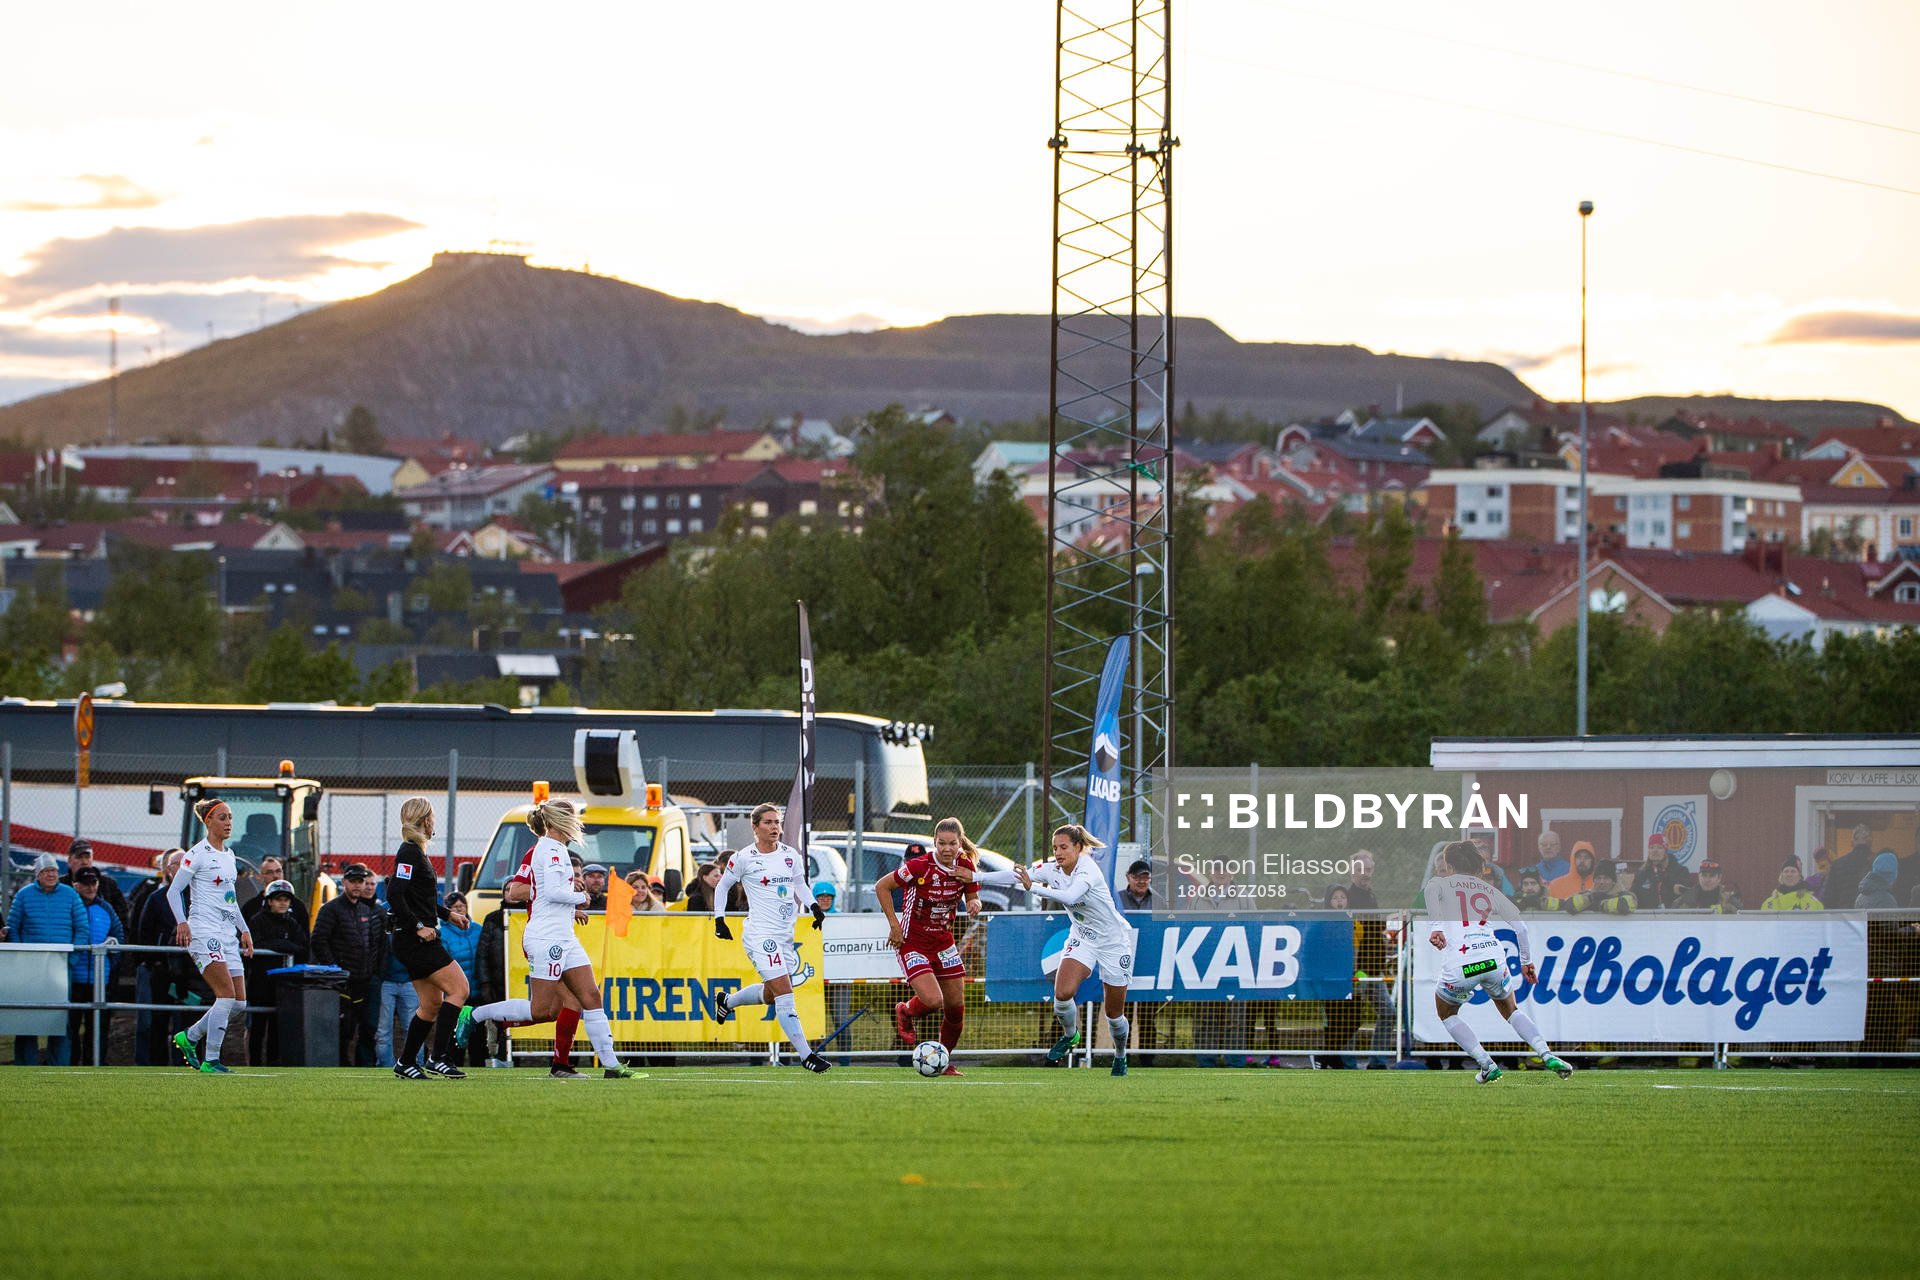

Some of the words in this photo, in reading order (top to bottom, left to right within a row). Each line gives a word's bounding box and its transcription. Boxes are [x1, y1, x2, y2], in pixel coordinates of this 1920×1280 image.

[1860, 772, 1889, 786] KAFFE
[1089, 774, 1121, 802] LKAB
[1449, 881, 1495, 897] LANDEKA
[1455, 890, 1493, 928] 19
[823, 941, 873, 954] Company
[767, 952, 782, 967] 14
[1127, 925, 1302, 990] LKAB
[548, 963, 562, 977] 10
[1463, 960, 1486, 975] akea
[524, 975, 741, 1021] IRENT
